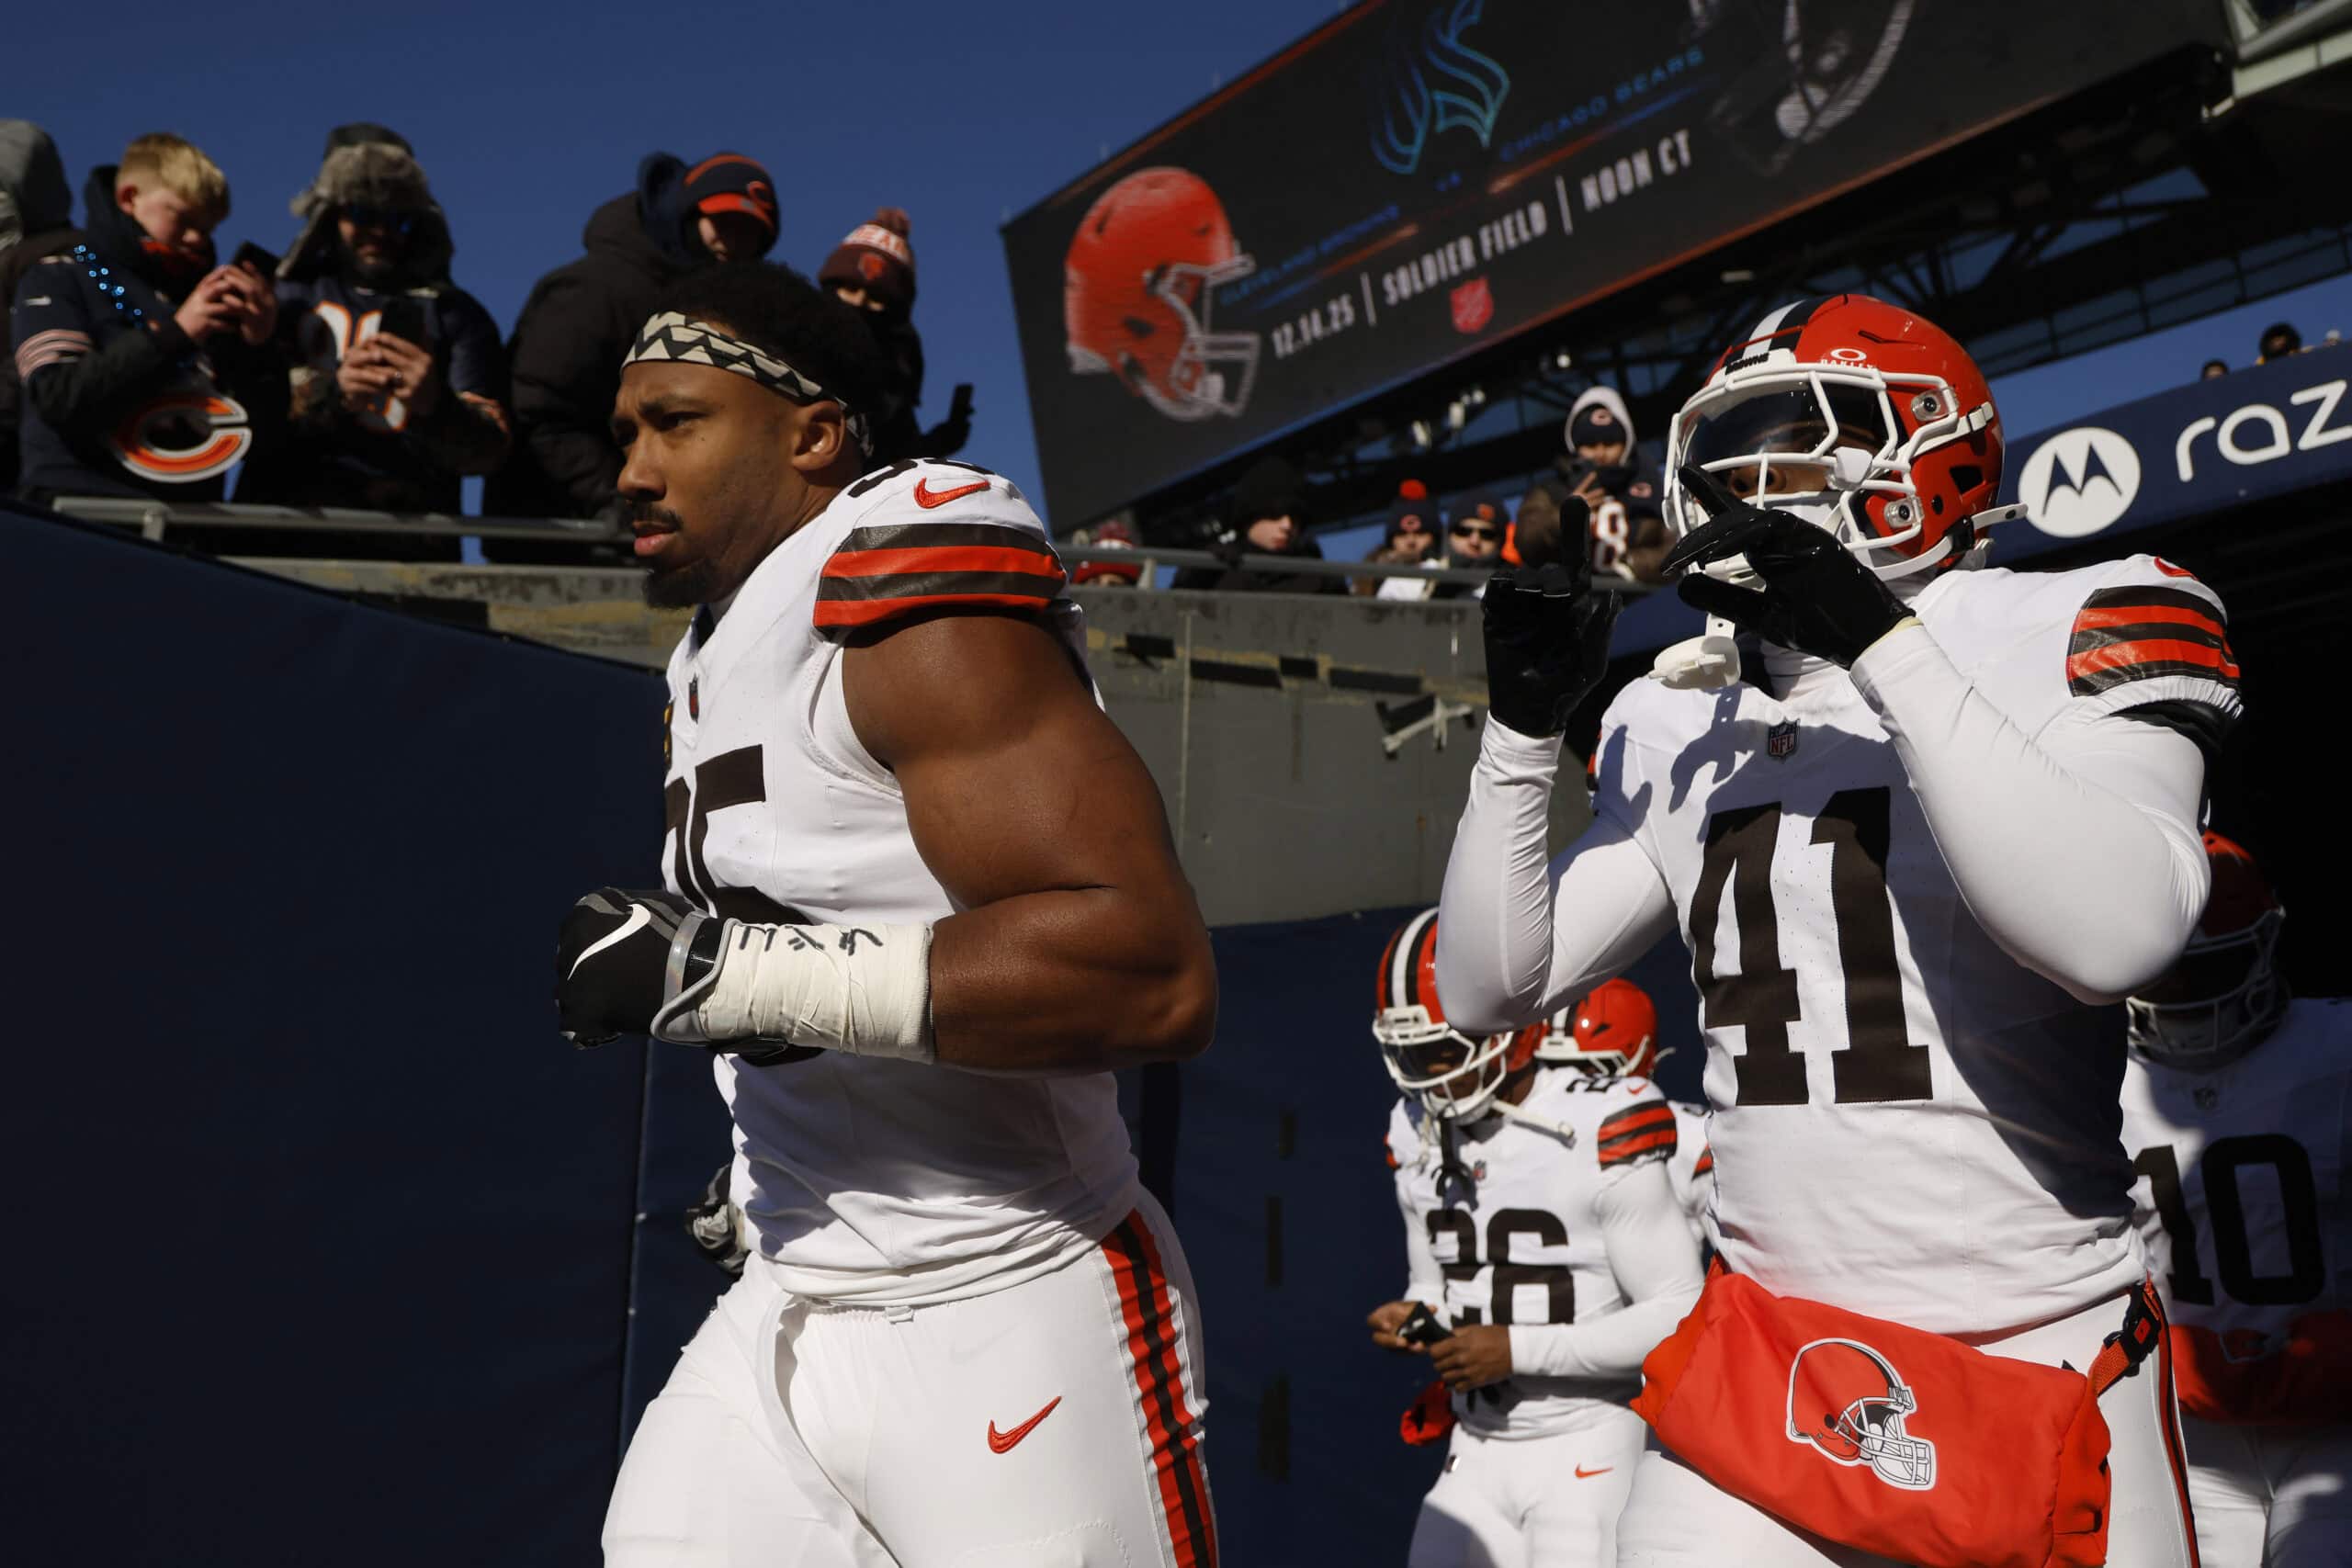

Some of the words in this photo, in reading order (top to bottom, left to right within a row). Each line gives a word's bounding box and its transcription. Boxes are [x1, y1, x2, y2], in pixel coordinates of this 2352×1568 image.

[1614, 46, 1703, 103] BEARS
[1272, 294, 1354, 359] 12.14.25
[1383, 235, 1476, 306] SOLDIER
[1478, 200, 1547, 261] FIELD
[1581, 149, 1653, 212] NOON
[1658, 129, 1691, 175] CT
[2176, 379, 2352, 482] raz
[1689, 786, 1934, 1106] 41
[2132, 1133, 2326, 1305] 10
